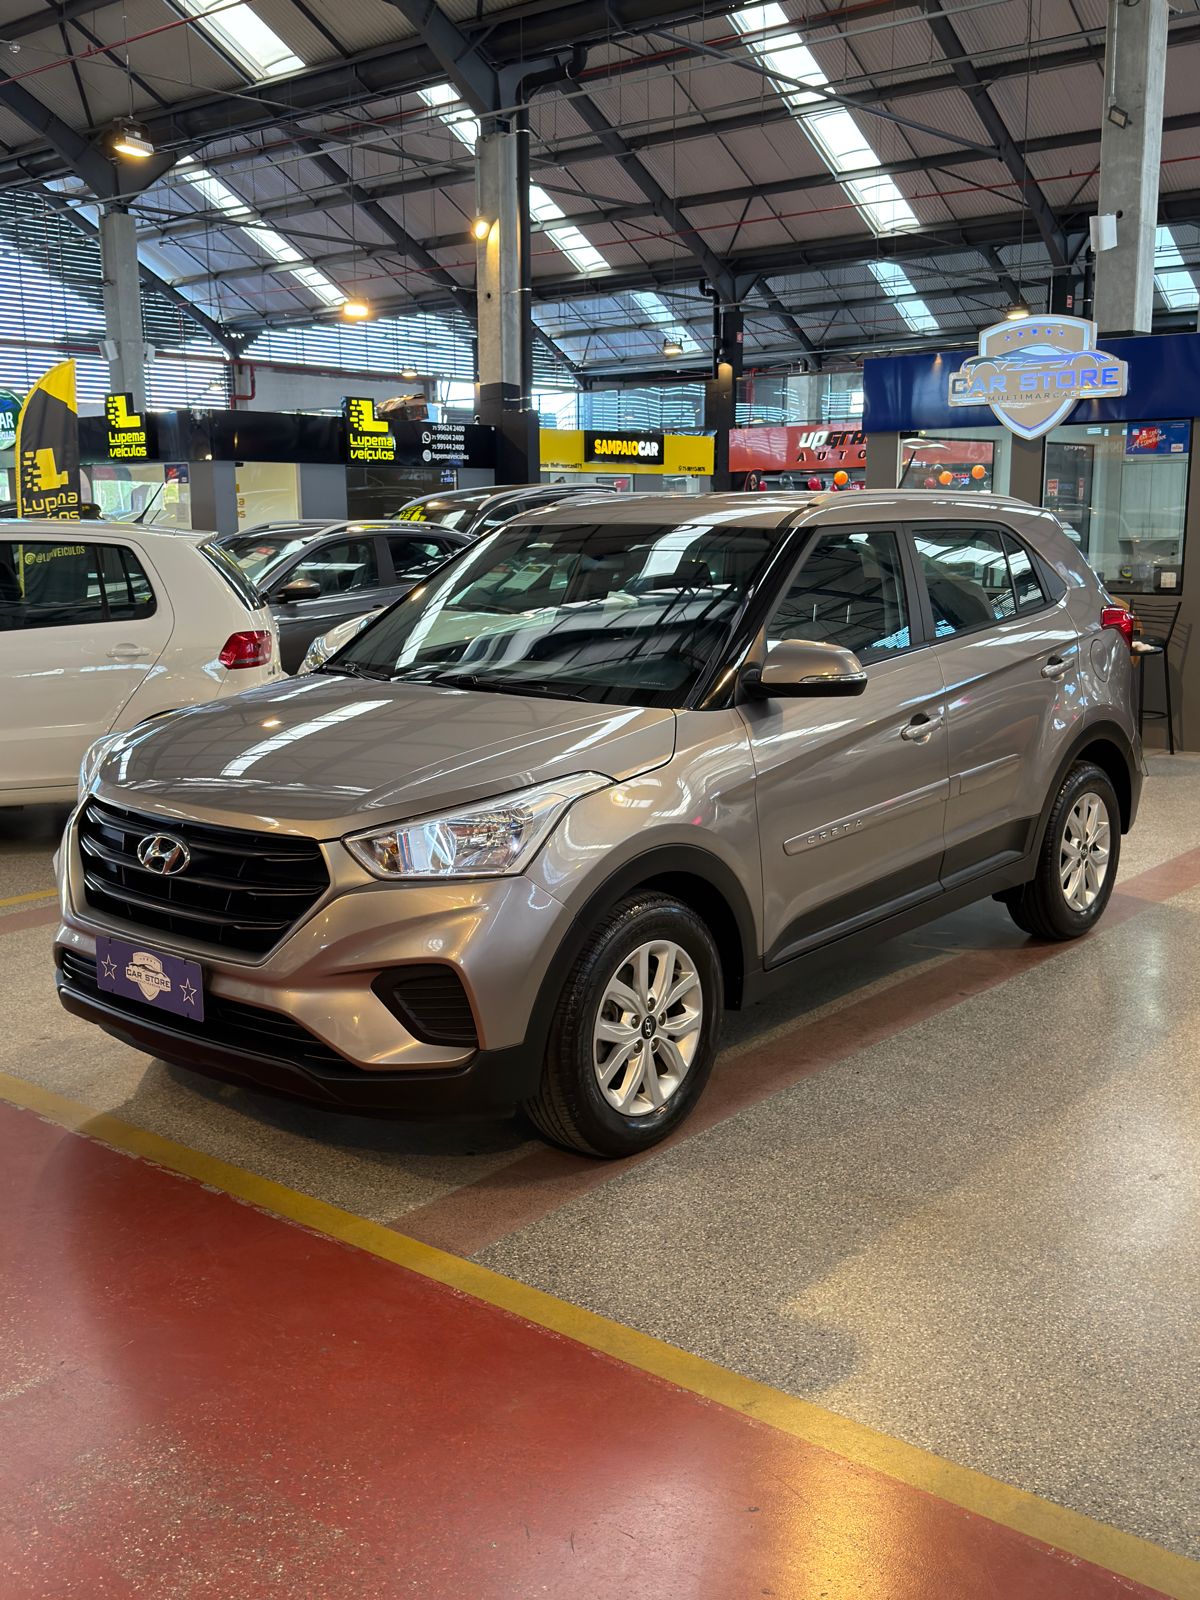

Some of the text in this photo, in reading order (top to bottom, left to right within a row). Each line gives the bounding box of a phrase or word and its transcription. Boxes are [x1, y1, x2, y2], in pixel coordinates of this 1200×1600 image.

[952, 367, 1119, 395] CAR STORE
[109, 431, 146, 443] Lupema
[350, 433, 393, 447] Lupema
[109, 444, 147, 457] veículos
[350, 448, 395, 460] veículos
[594, 439, 659, 457] SAMPAIOCAR
[807, 819, 863, 845] CRETA
[126, 968, 142, 981] CAR
[145, 974, 170, 989] STORE
